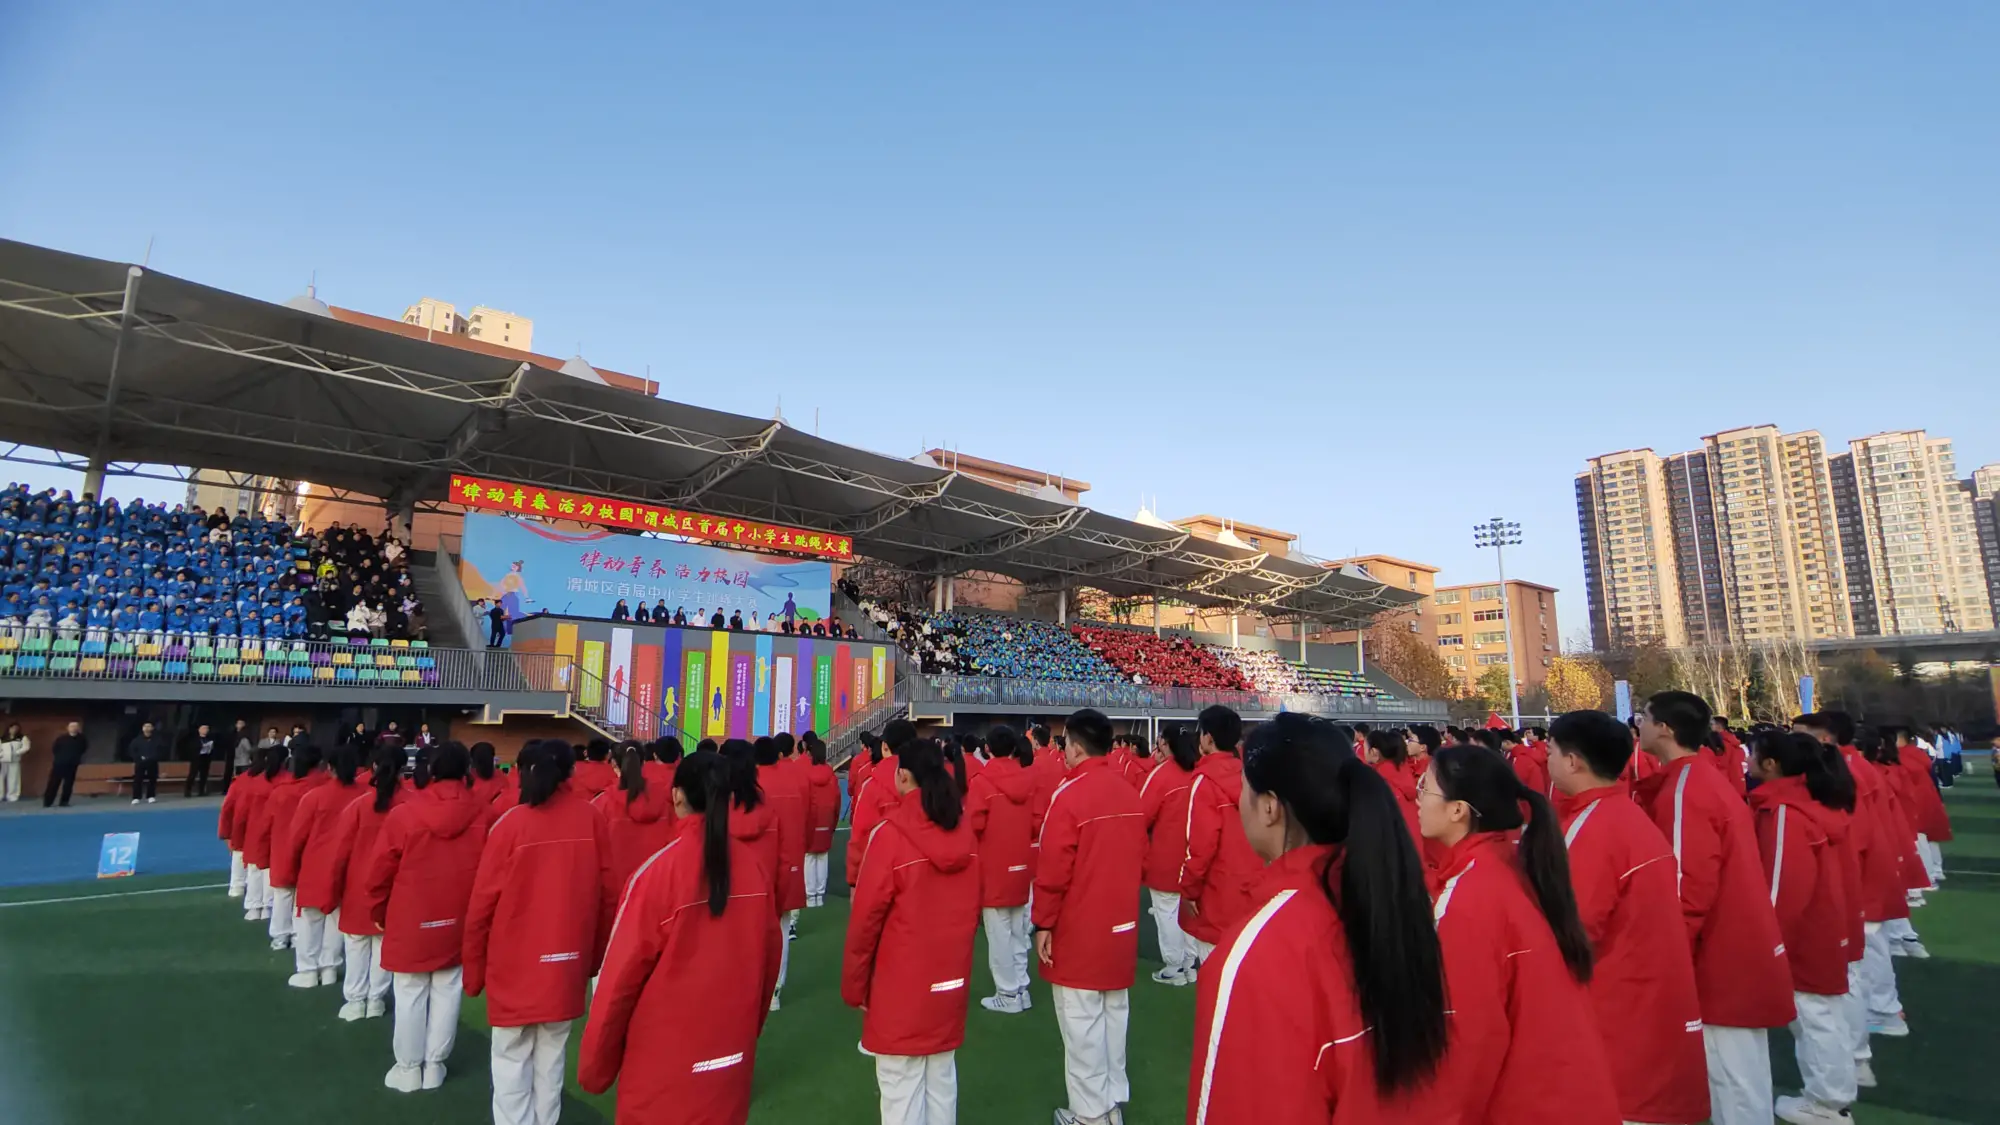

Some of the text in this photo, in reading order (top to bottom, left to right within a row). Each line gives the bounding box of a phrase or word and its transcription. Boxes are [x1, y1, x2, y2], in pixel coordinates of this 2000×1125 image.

[580, 550, 750, 588] 律动青春 活力校园
[107, 846, 131, 865] 12
